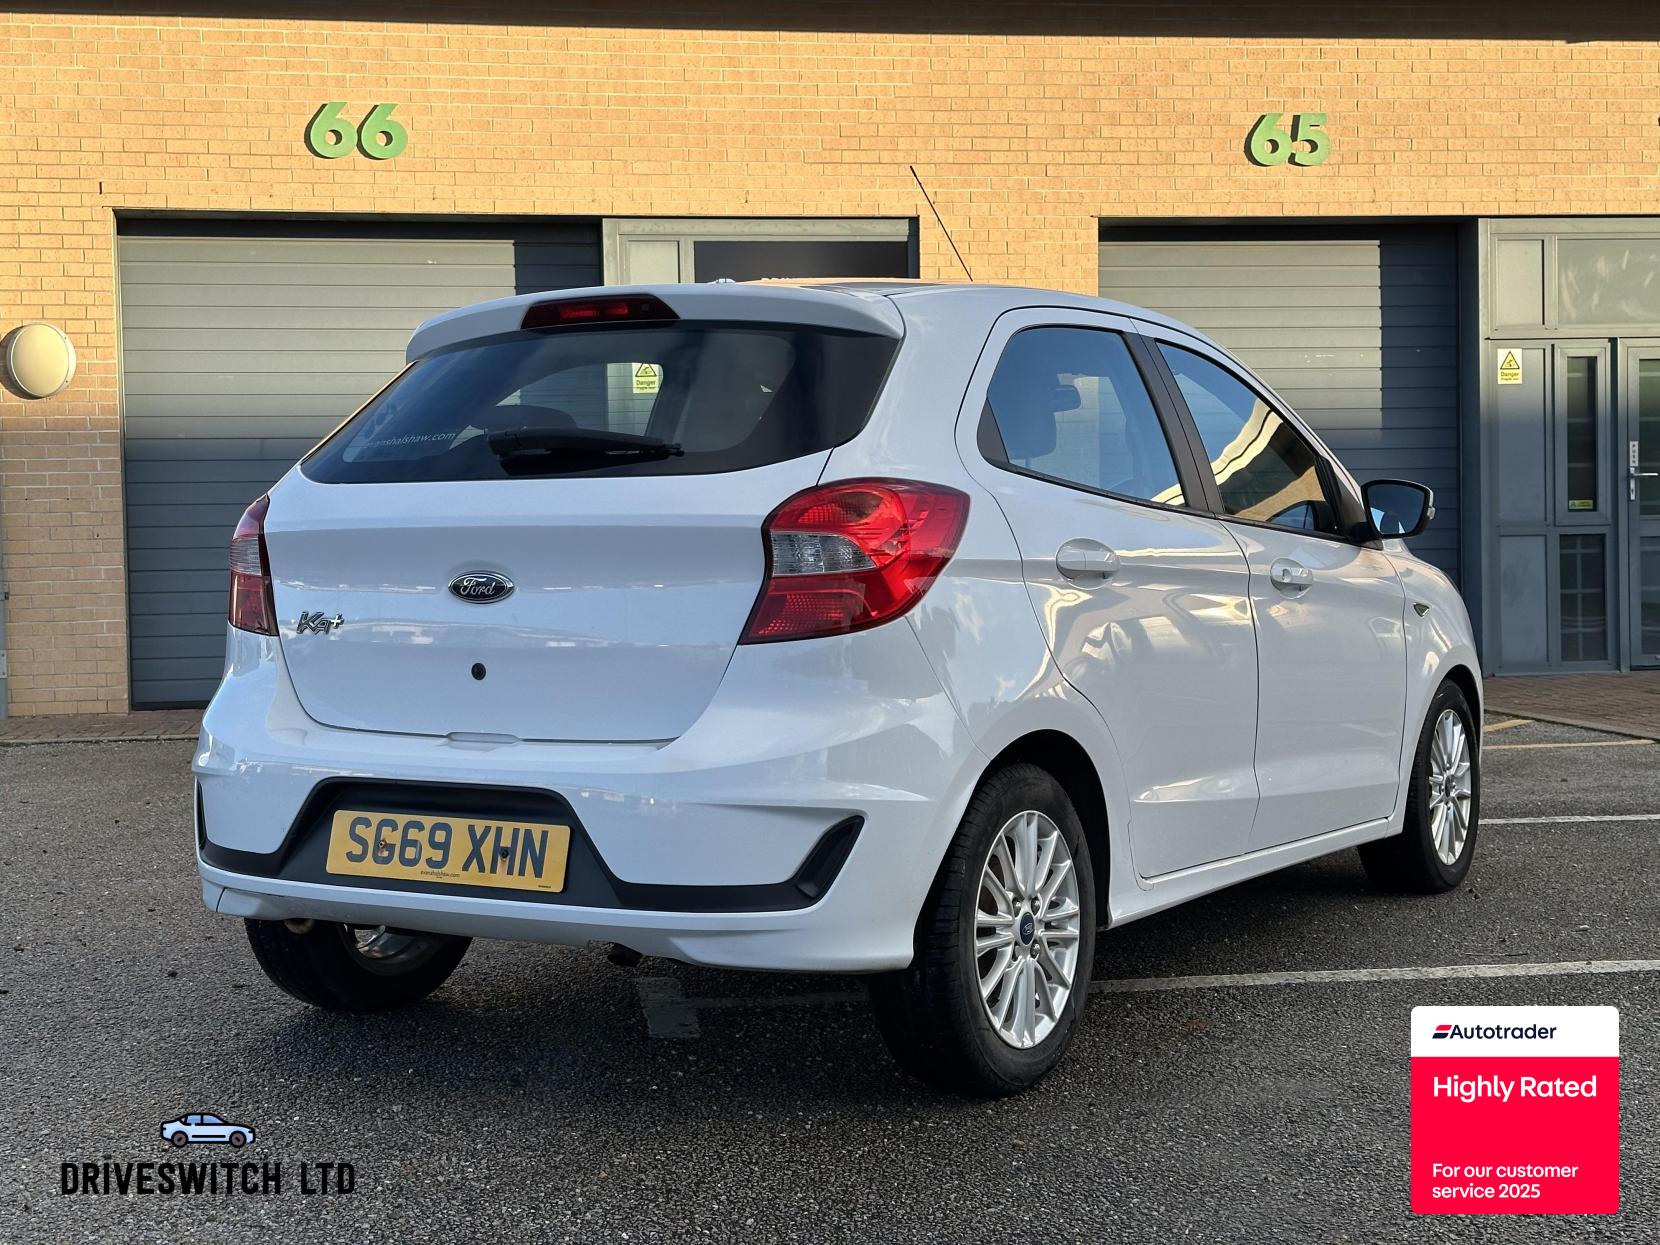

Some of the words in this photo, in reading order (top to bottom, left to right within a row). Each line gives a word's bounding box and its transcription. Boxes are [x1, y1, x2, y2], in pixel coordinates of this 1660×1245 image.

[305, 102, 408, 160] 66
[1244, 113, 1331, 167] 65
[460, 577, 497, 596] Ford
[345, 816, 453, 870] SG69
[461, 824, 549, 879] XHN
